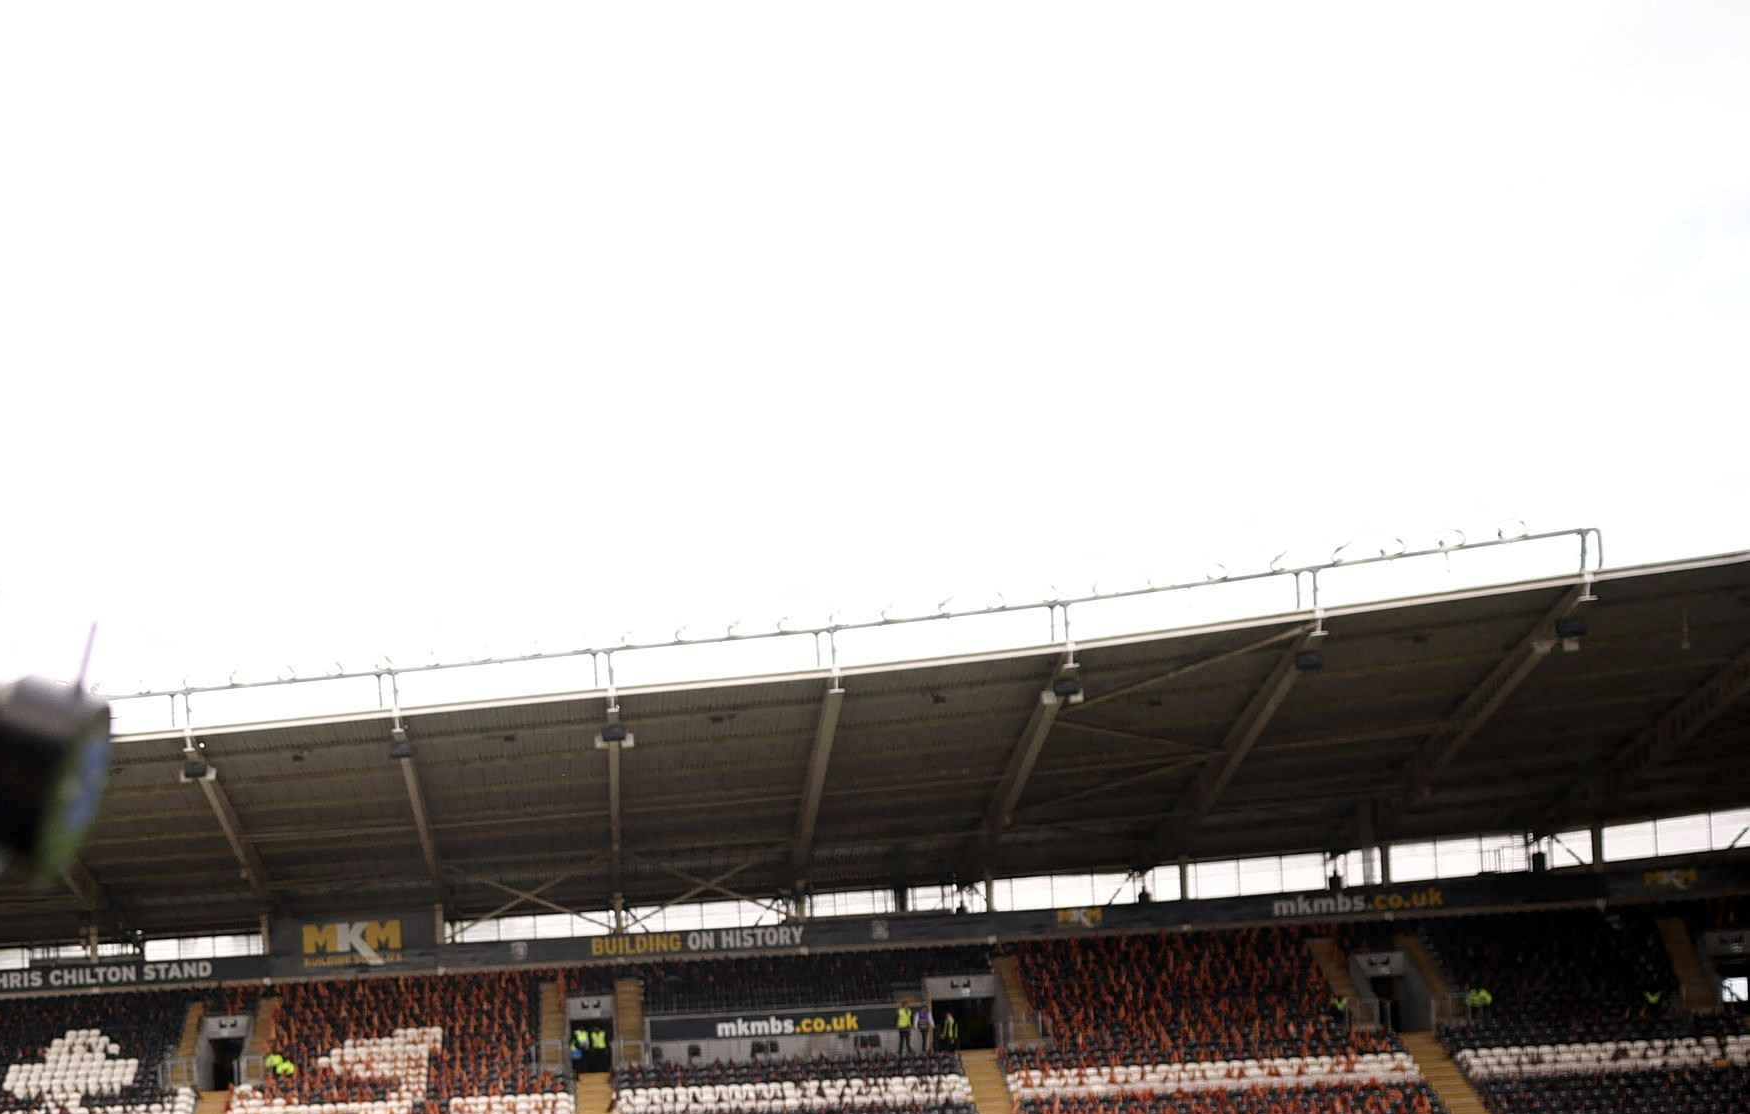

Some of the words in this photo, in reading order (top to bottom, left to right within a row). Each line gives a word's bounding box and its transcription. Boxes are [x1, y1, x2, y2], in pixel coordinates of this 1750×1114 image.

[1273, 886, 1444, 916] mkmbs.co.uk
[302, 919, 402, 965] MKM
[591, 932, 682, 955] BUILDING
[687, 931, 715, 950] ON
[720, 925, 804, 949] HISTORY
[49, 965, 136, 985] CHILTON
[143, 961, 213, 981] STAND
[716, 1012, 859, 1037] mkmbs.co.uk
